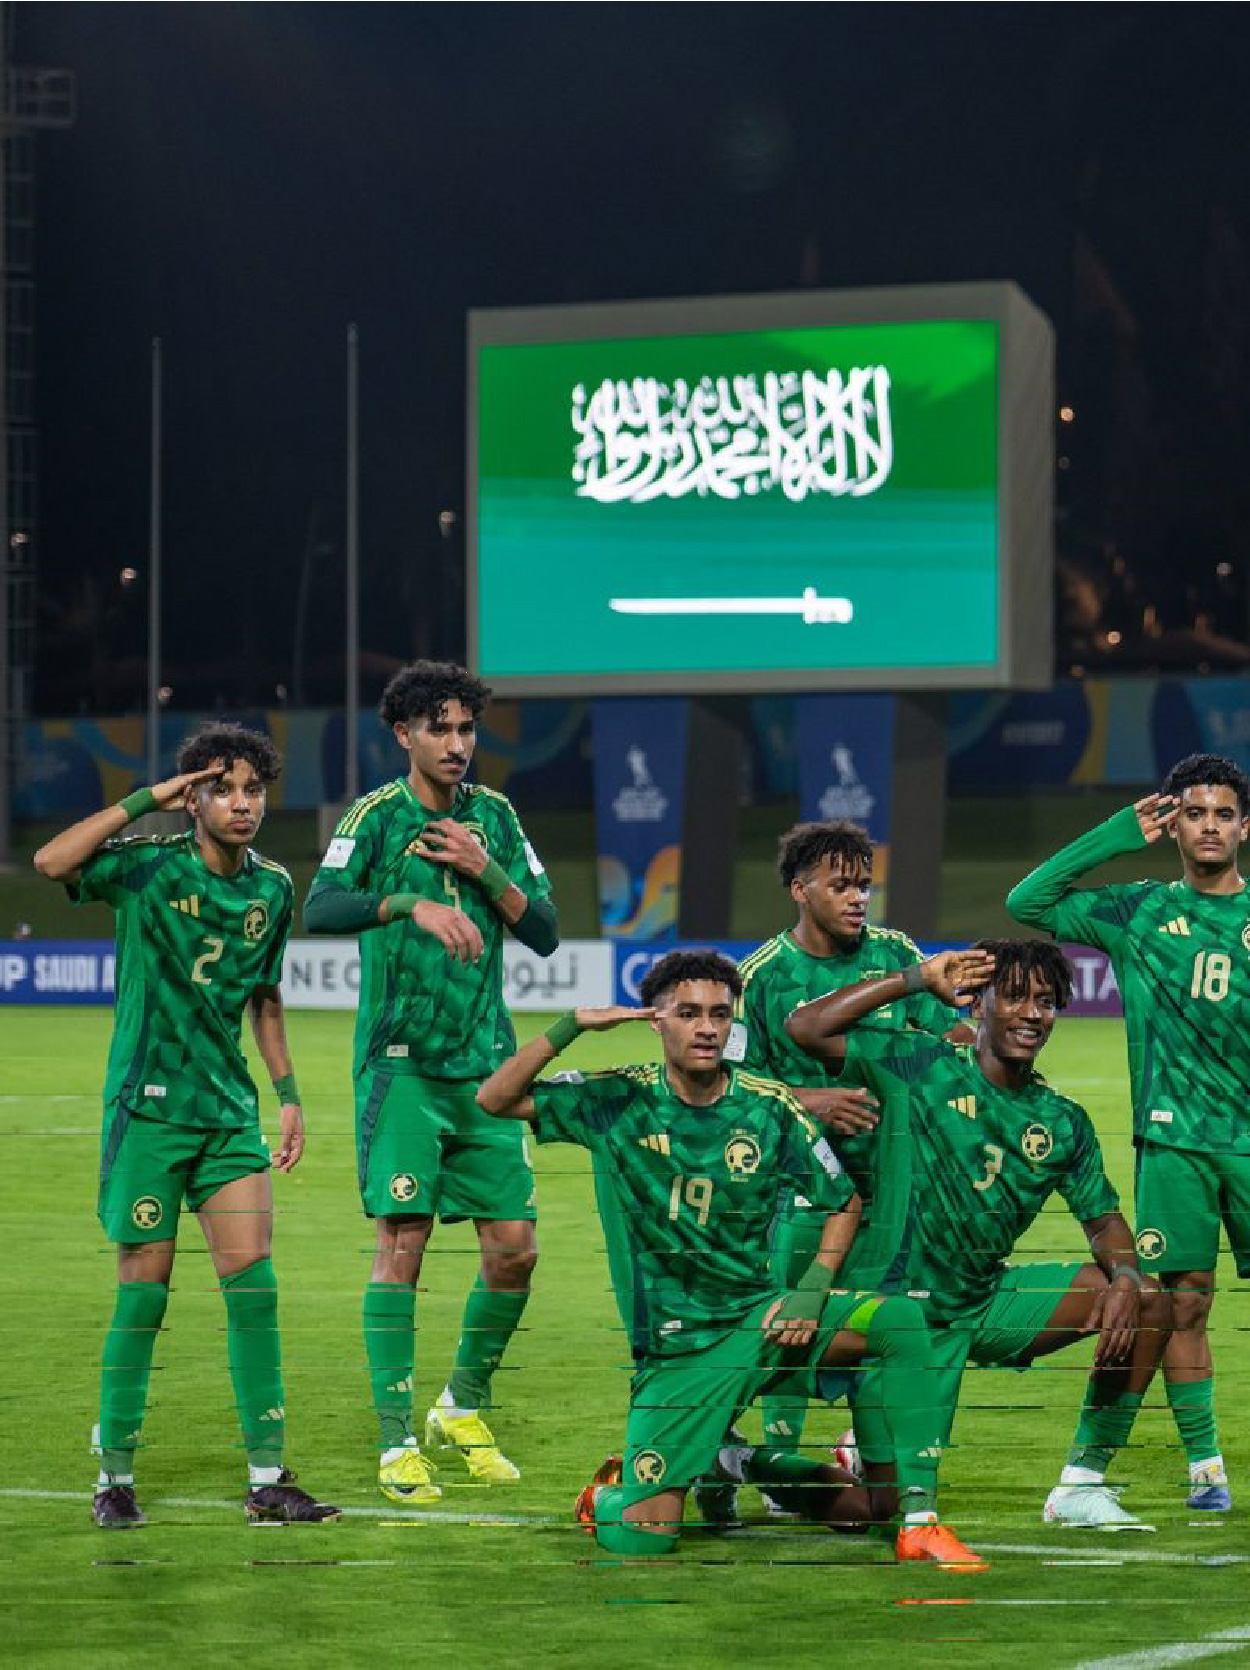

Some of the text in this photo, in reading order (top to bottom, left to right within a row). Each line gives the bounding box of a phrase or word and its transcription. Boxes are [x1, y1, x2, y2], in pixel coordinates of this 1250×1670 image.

[0, 954, 28, 991] P
[34, 954, 98, 991] SAUDI
[191, 935, 224, 985] 2
[290, 959, 360, 992] NEO
[503, 952, 579, 999] نيو
[1190, 950, 1232, 1001] 18
[972, 1142, 1003, 1191] 3
[668, 1174, 713, 1226] 19
